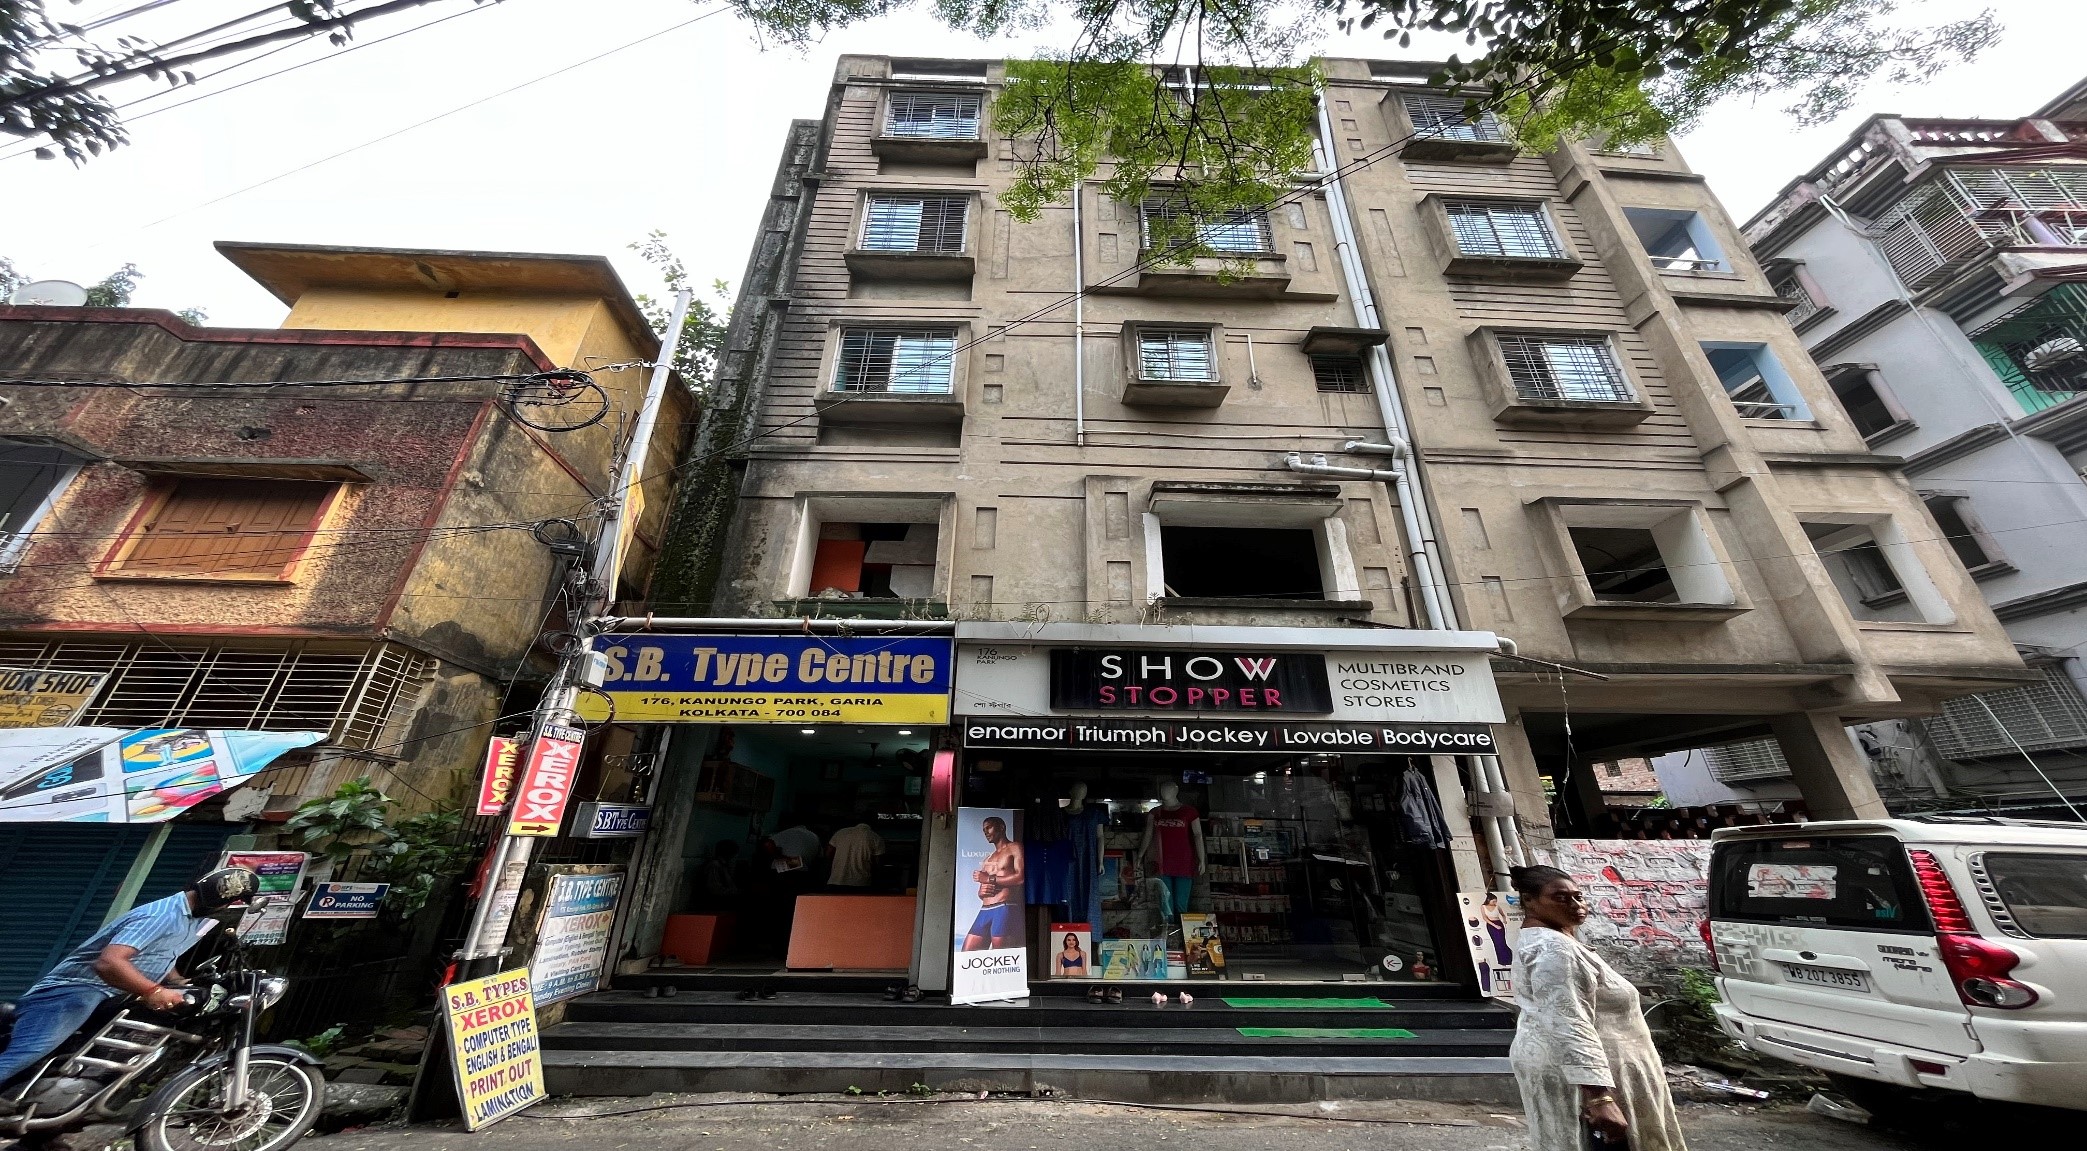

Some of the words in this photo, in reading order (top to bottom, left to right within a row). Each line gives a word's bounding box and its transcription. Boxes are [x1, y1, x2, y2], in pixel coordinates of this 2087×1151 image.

[606, 647, 670, 681] S.B.
[693, 648, 789, 686] Type
[798, 648, 935, 684] Centre
[1101, 655, 1277, 681] SHOW
[1338, 663, 1465, 676] MULTIBRAND
[36, 673, 100, 695] SHOP
[1341, 679, 1451, 691] COSMETICS
[640, 697, 676, 707] 176,
[680, 697, 766, 706] KANUNGO
[773, 697, 824, 707] PARK,
[830, 697, 884, 706] GARIA
[1100, 685, 1282, 707] STOPPER
[1343, 696, 1416, 708] STORES
[680, 708, 759, 718] KOLKATA
[776, 708, 808, 718] 700
[811, 708, 841, 718] 084
[969, 726, 1066, 740] enamor
[1076, 725, 1166, 746] Triumph
[1176, 726, 1268, 747] Jockey
[1283, 728, 1373, 745] Lovable
[1383, 729, 1491, 748] Bodycare
[488, 740, 519, 804] XEROX
[520, 740, 577, 821] XEROX
[574, 880, 595, 901] TYPE
[561, 914, 602, 932] XEROX
[962, 955, 1021, 970] JOCKEY
[982, 967, 992, 976] OR
[992, 966, 1021, 976] NOTHING
[1788, 964, 1803, 979] WB
[1829, 972, 1861, 987] 3855
[451, 992, 479, 1010] S.B.
[483, 977, 528, 1002] TYPES
[460, 996, 529, 1032] XEROX
[463, 1024, 510, 1054] COMPUTER
[510, 1017, 532, 1039] TYPE
[466, 1049, 499, 1076] ENGLISH
[500, 1048, 505, 1063] &
[507, 1034, 538, 1060] BENGALI
[469, 1068, 505, 1099] PRINT
[508, 1058, 532, 1083] OUT
[473, 1081, 535, 1123] LAMINATION
